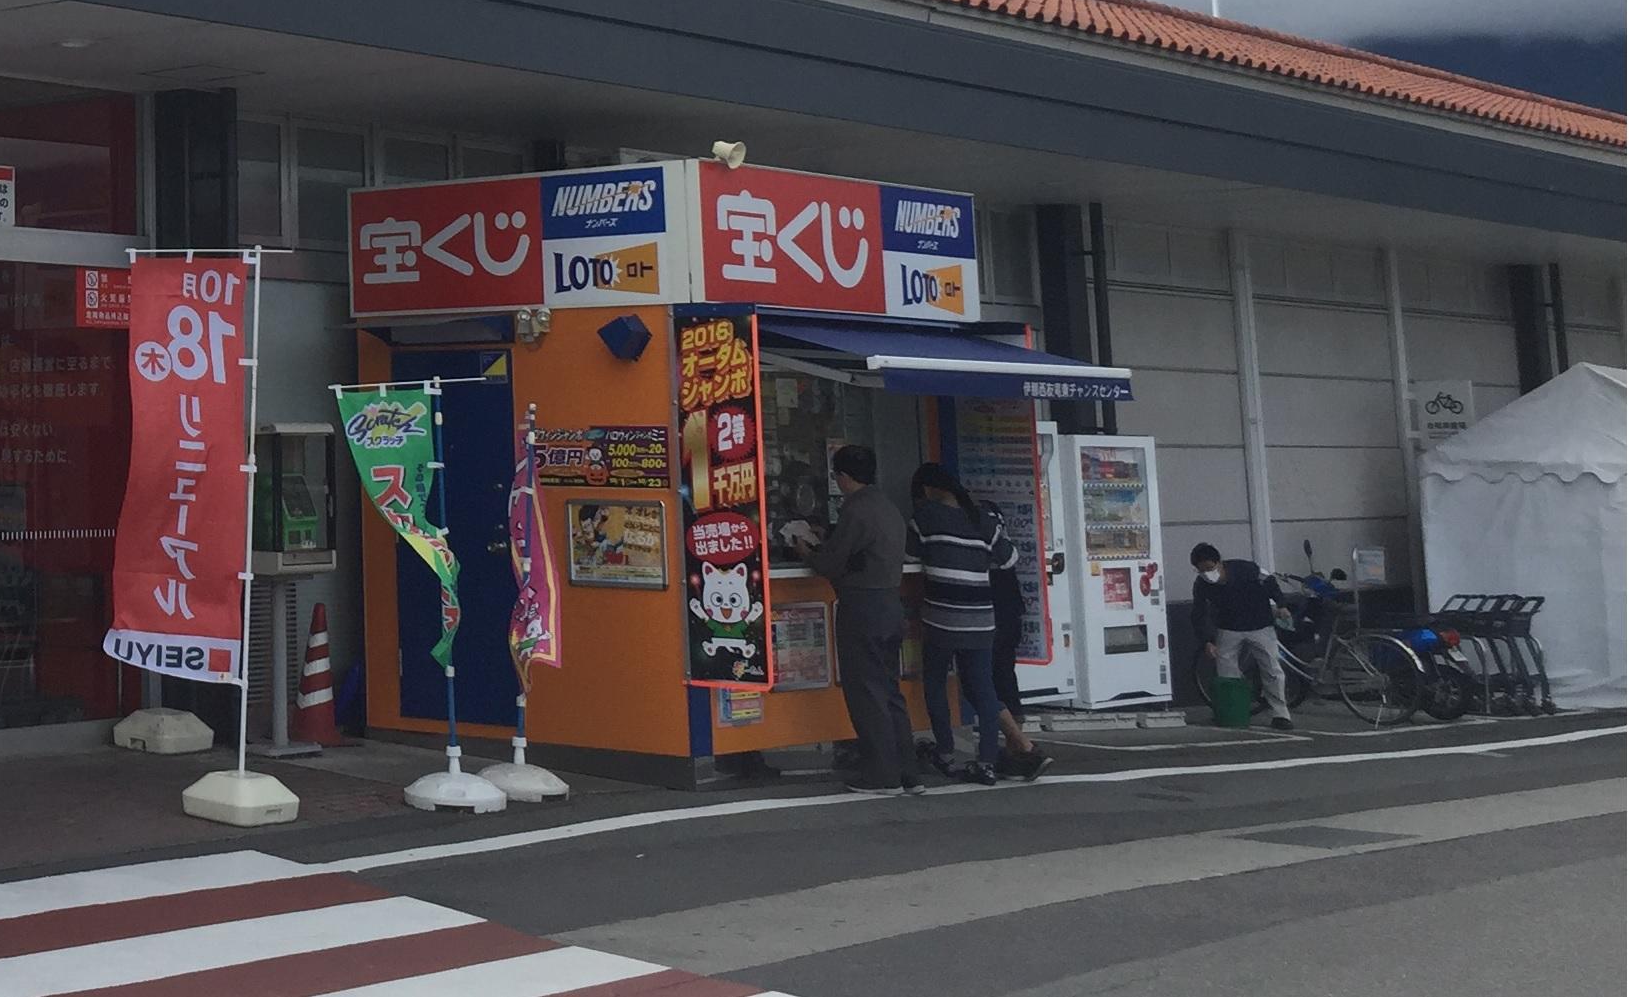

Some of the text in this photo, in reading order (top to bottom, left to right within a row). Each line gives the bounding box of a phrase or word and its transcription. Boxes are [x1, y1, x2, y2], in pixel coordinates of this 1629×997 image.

[551, 179, 656, 217] NUMBERS
[716, 189, 869, 288] 宝くじ
[894, 199, 961, 239] NUMBERS
[359, 210, 530, 285] 宝くじ
[553, 251, 615, 294] LOTO
[900, 263, 938, 306] LOTO
[682, 340, 747, 377] オータム
[682, 367, 747, 406] ジャンボ
[717, 412, 745, 451] 2等
[692, 521, 748, 540] 当売場から
